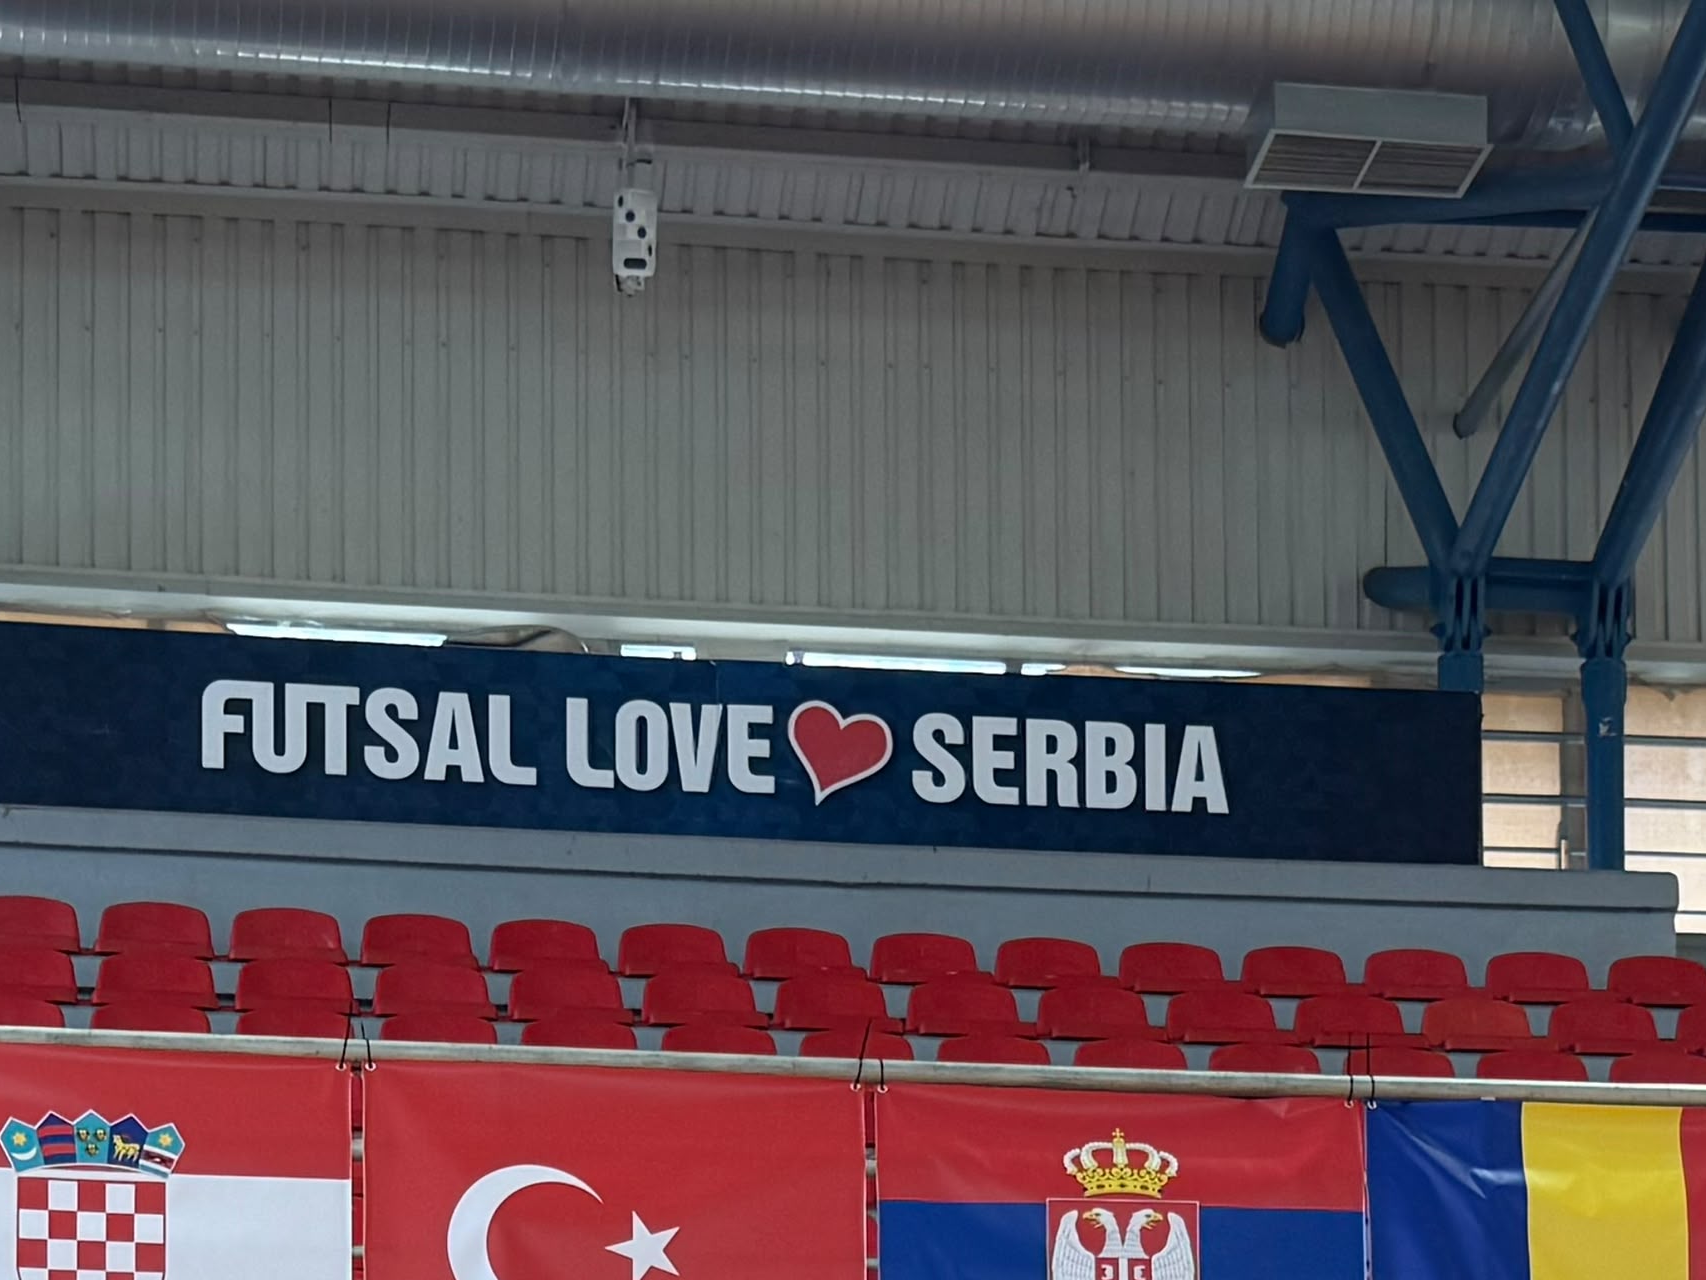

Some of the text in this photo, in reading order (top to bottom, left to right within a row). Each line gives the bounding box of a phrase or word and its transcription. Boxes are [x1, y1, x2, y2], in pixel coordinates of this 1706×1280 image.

[200, 679, 1230, 814] FUTSAL LOVE SERBIA
